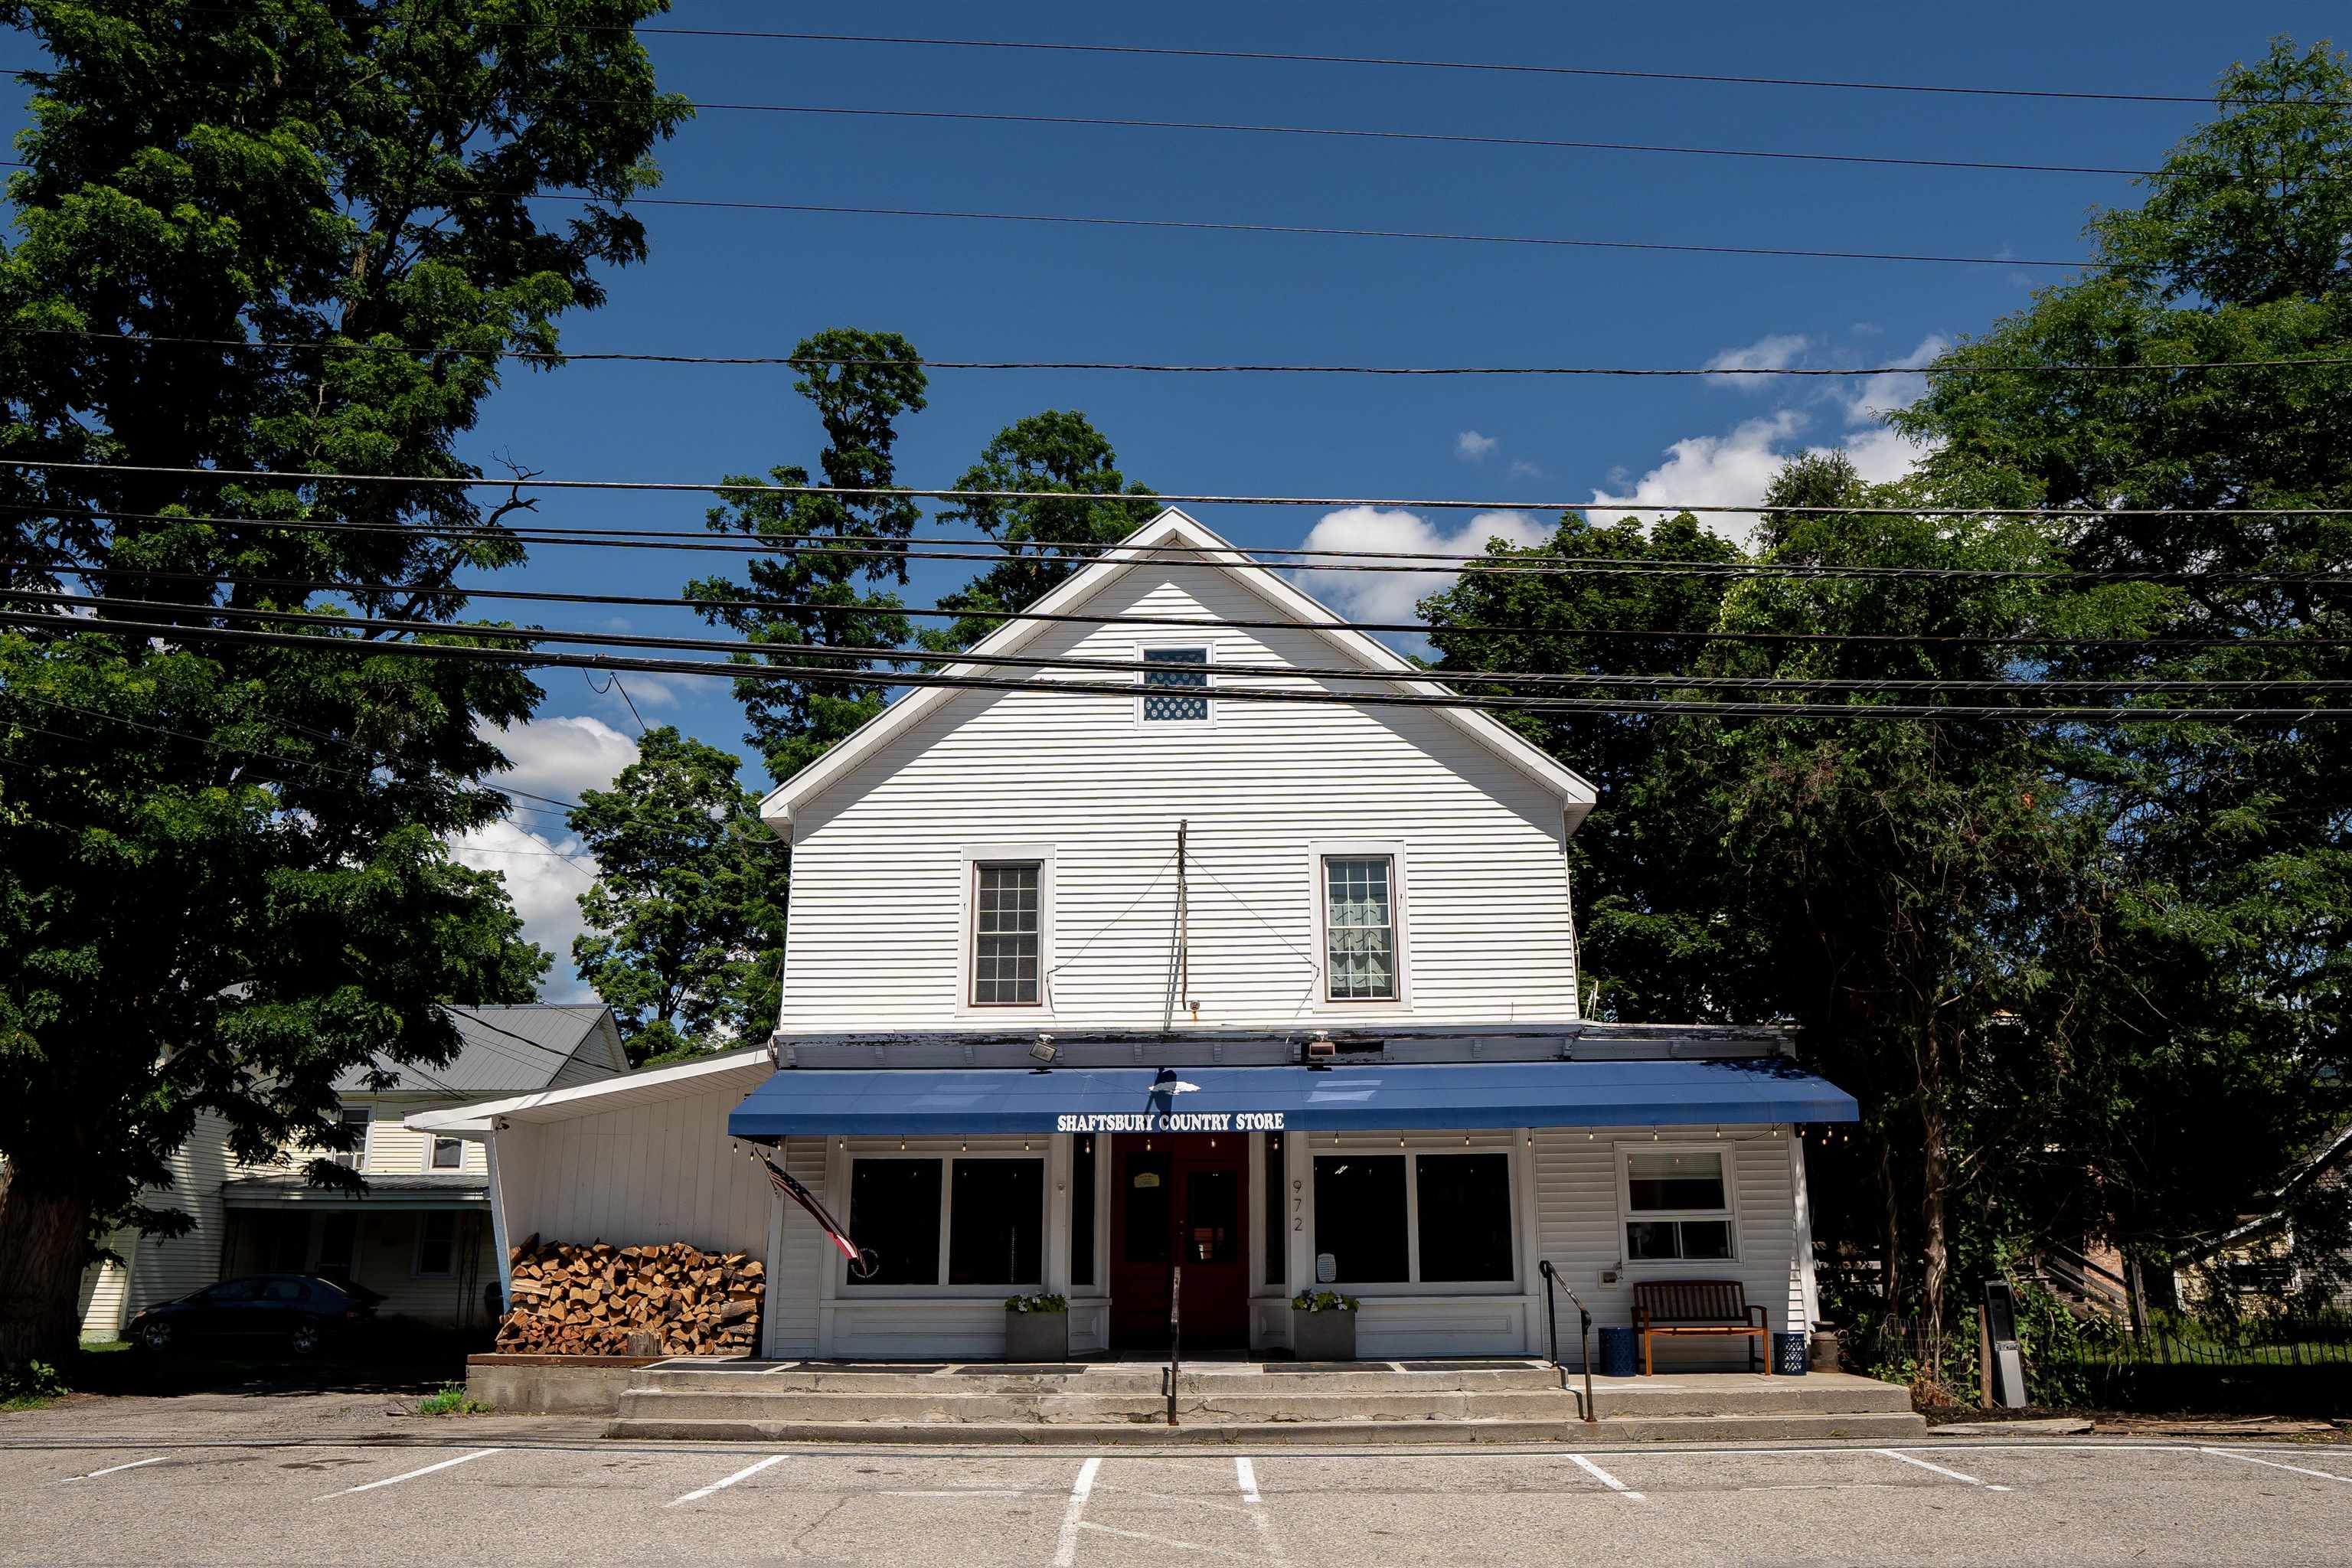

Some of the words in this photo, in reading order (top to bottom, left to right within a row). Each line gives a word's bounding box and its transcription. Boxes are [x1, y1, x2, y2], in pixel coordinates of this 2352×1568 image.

[1057, 1114, 1153, 1132] SHAFTSBURY
[1159, 1113, 1230, 1131] COUNTRY
[1236, 1112, 1284, 1130] STORE
[1292, 1181, 1303, 1231] 972
